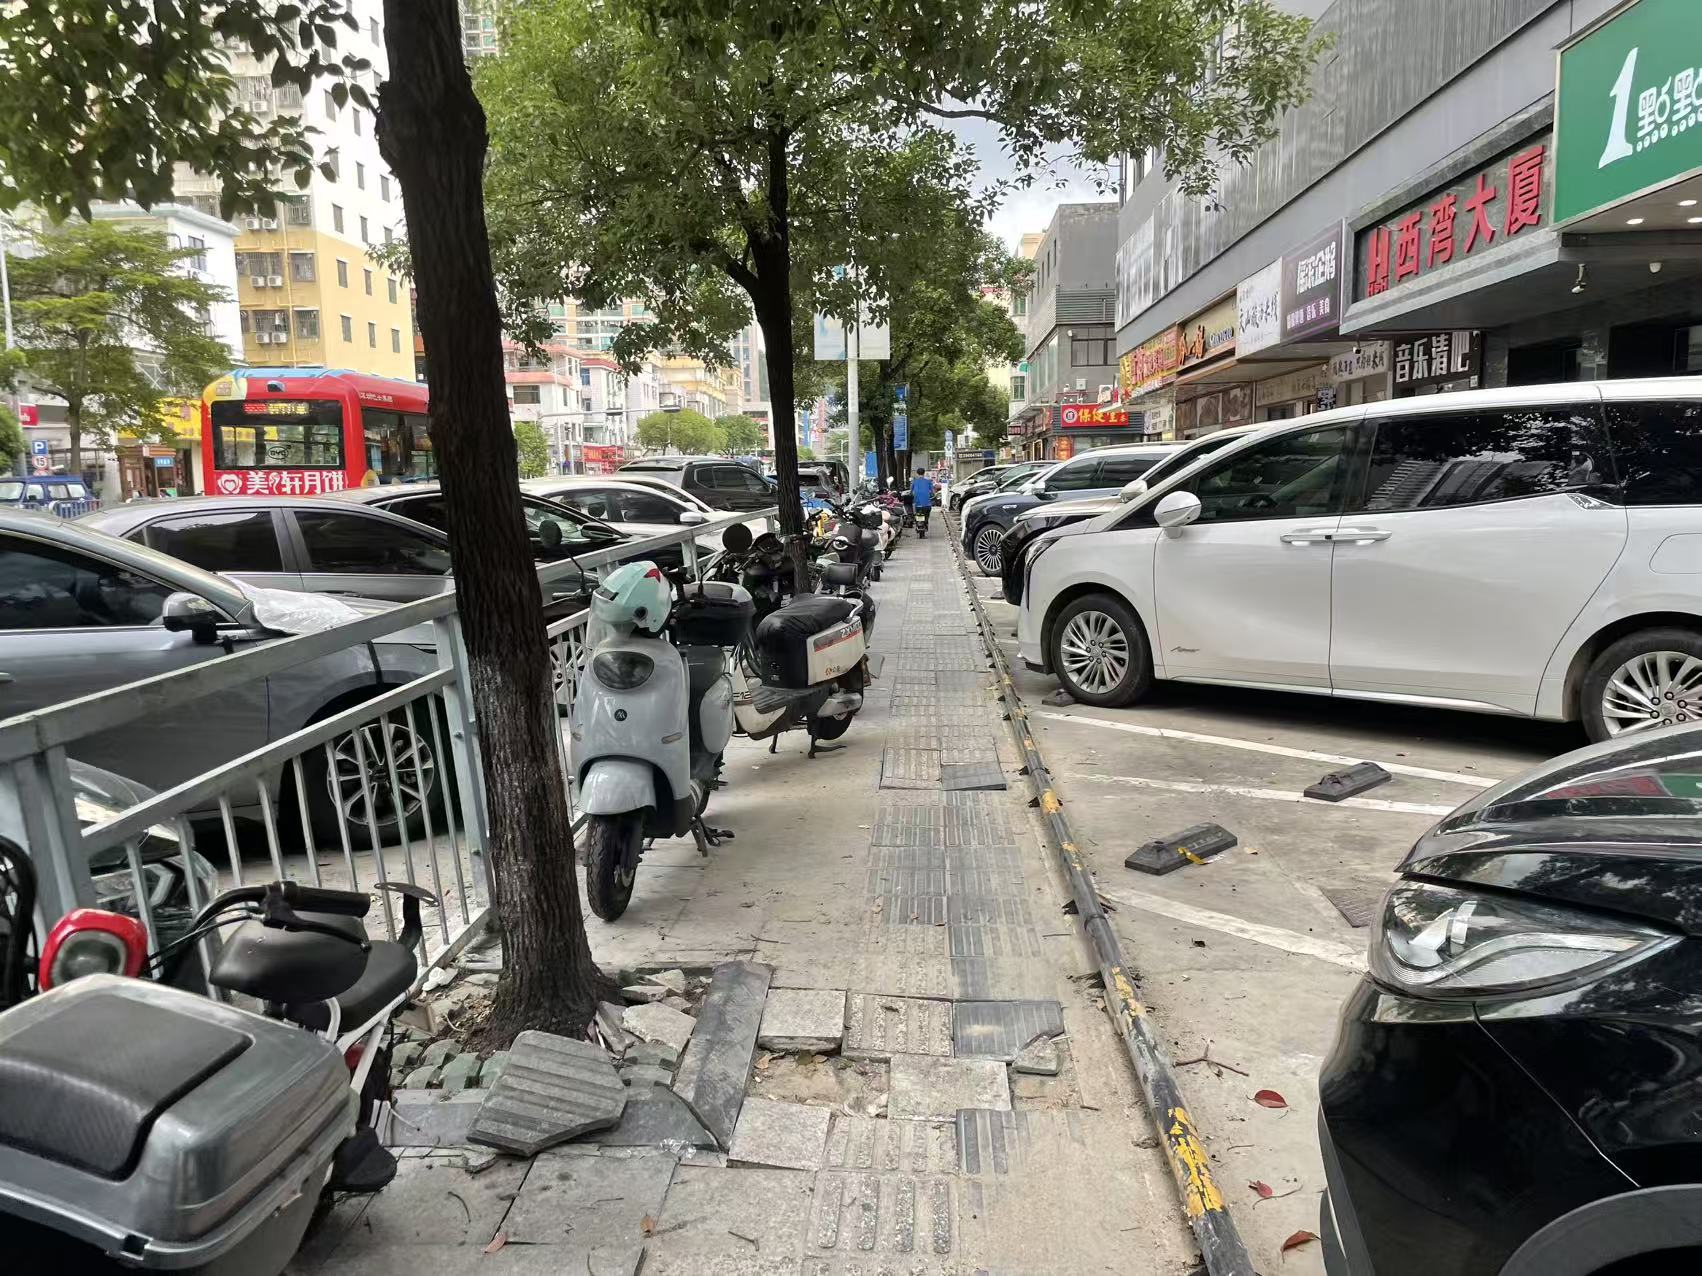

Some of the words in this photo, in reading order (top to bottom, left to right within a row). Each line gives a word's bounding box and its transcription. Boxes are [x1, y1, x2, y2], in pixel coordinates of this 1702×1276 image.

[1395, 145, 1544, 282] 西湾大厦
[1395, 331, 1470, 383] 音乐清吧
[34, 442, 45, 453] P
